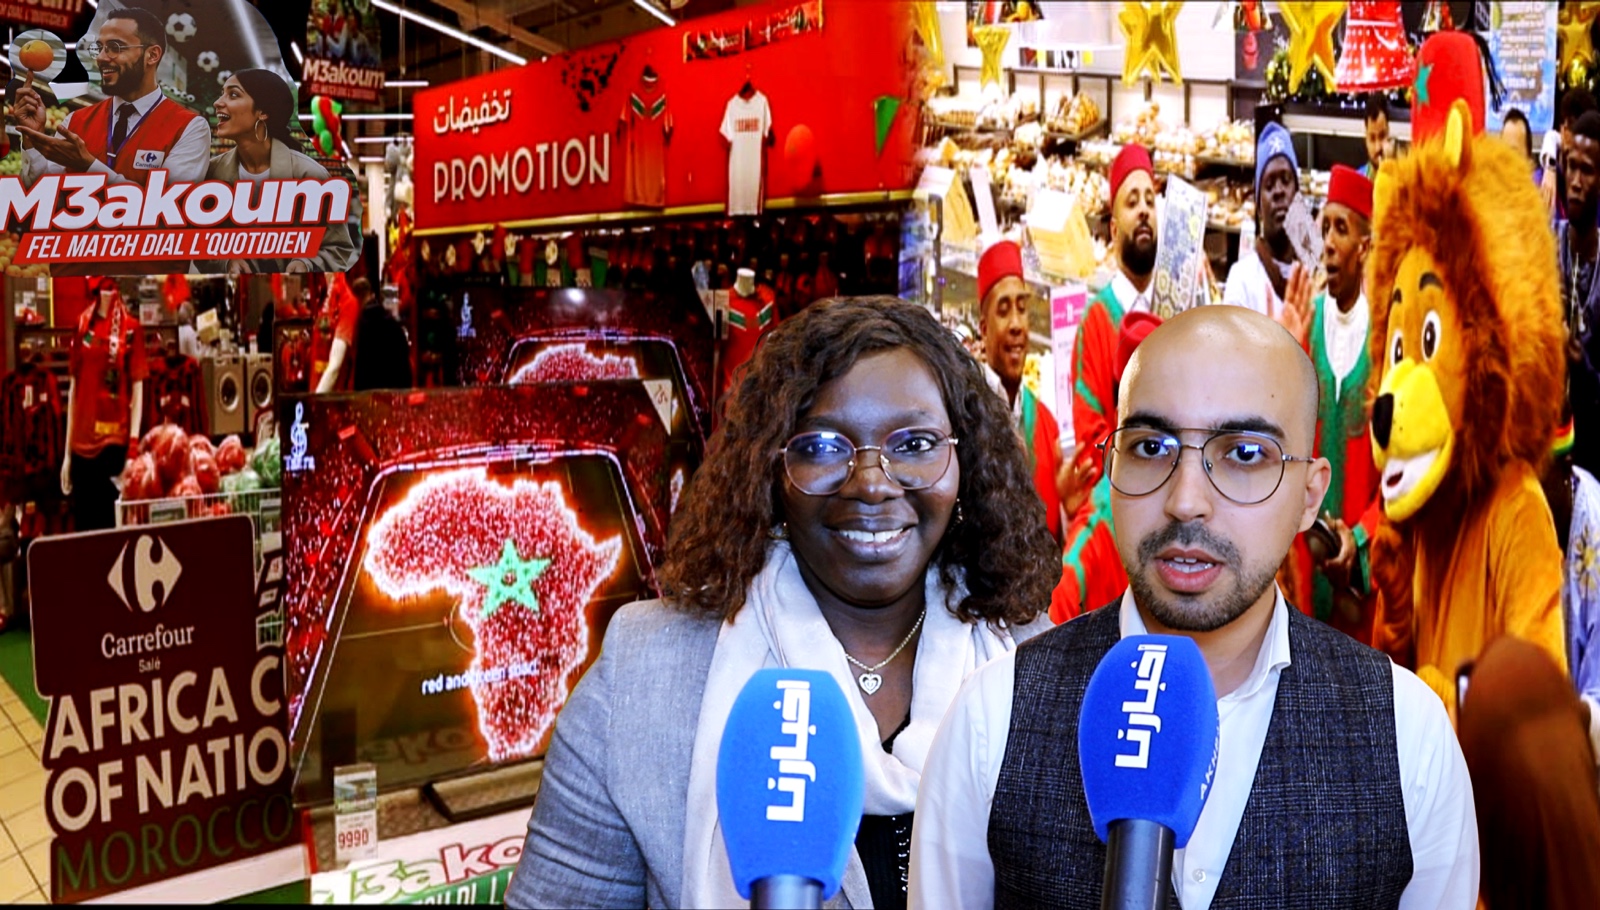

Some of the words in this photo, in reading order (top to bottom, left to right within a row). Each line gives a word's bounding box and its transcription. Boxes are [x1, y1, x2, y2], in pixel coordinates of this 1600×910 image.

[303, 59, 385, 89] M3akoum
[434, 89, 511, 133] تخفيضات
[434, 132, 610, 203] PROMOTION
[0, 169, 350, 231] M3akoum
[26, 235, 61, 258] FEL
[66, 233, 140, 258] MATCH
[140, 231, 184, 256] DIAL
[189, 231, 311, 256] L'QUOTIDIEN
[101, 623, 194, 658] Carrefour
[139, 656, 160, 673] Salé
[421, 674, 443, 694] red
[50, 667, 238, 759] AFRICA
[251, 655, 288, 716] C
[52, 760, 124, 831] OF
[136, 726, 286, 814] NATIO
[57, 794, 293, 897] MOROCCO
